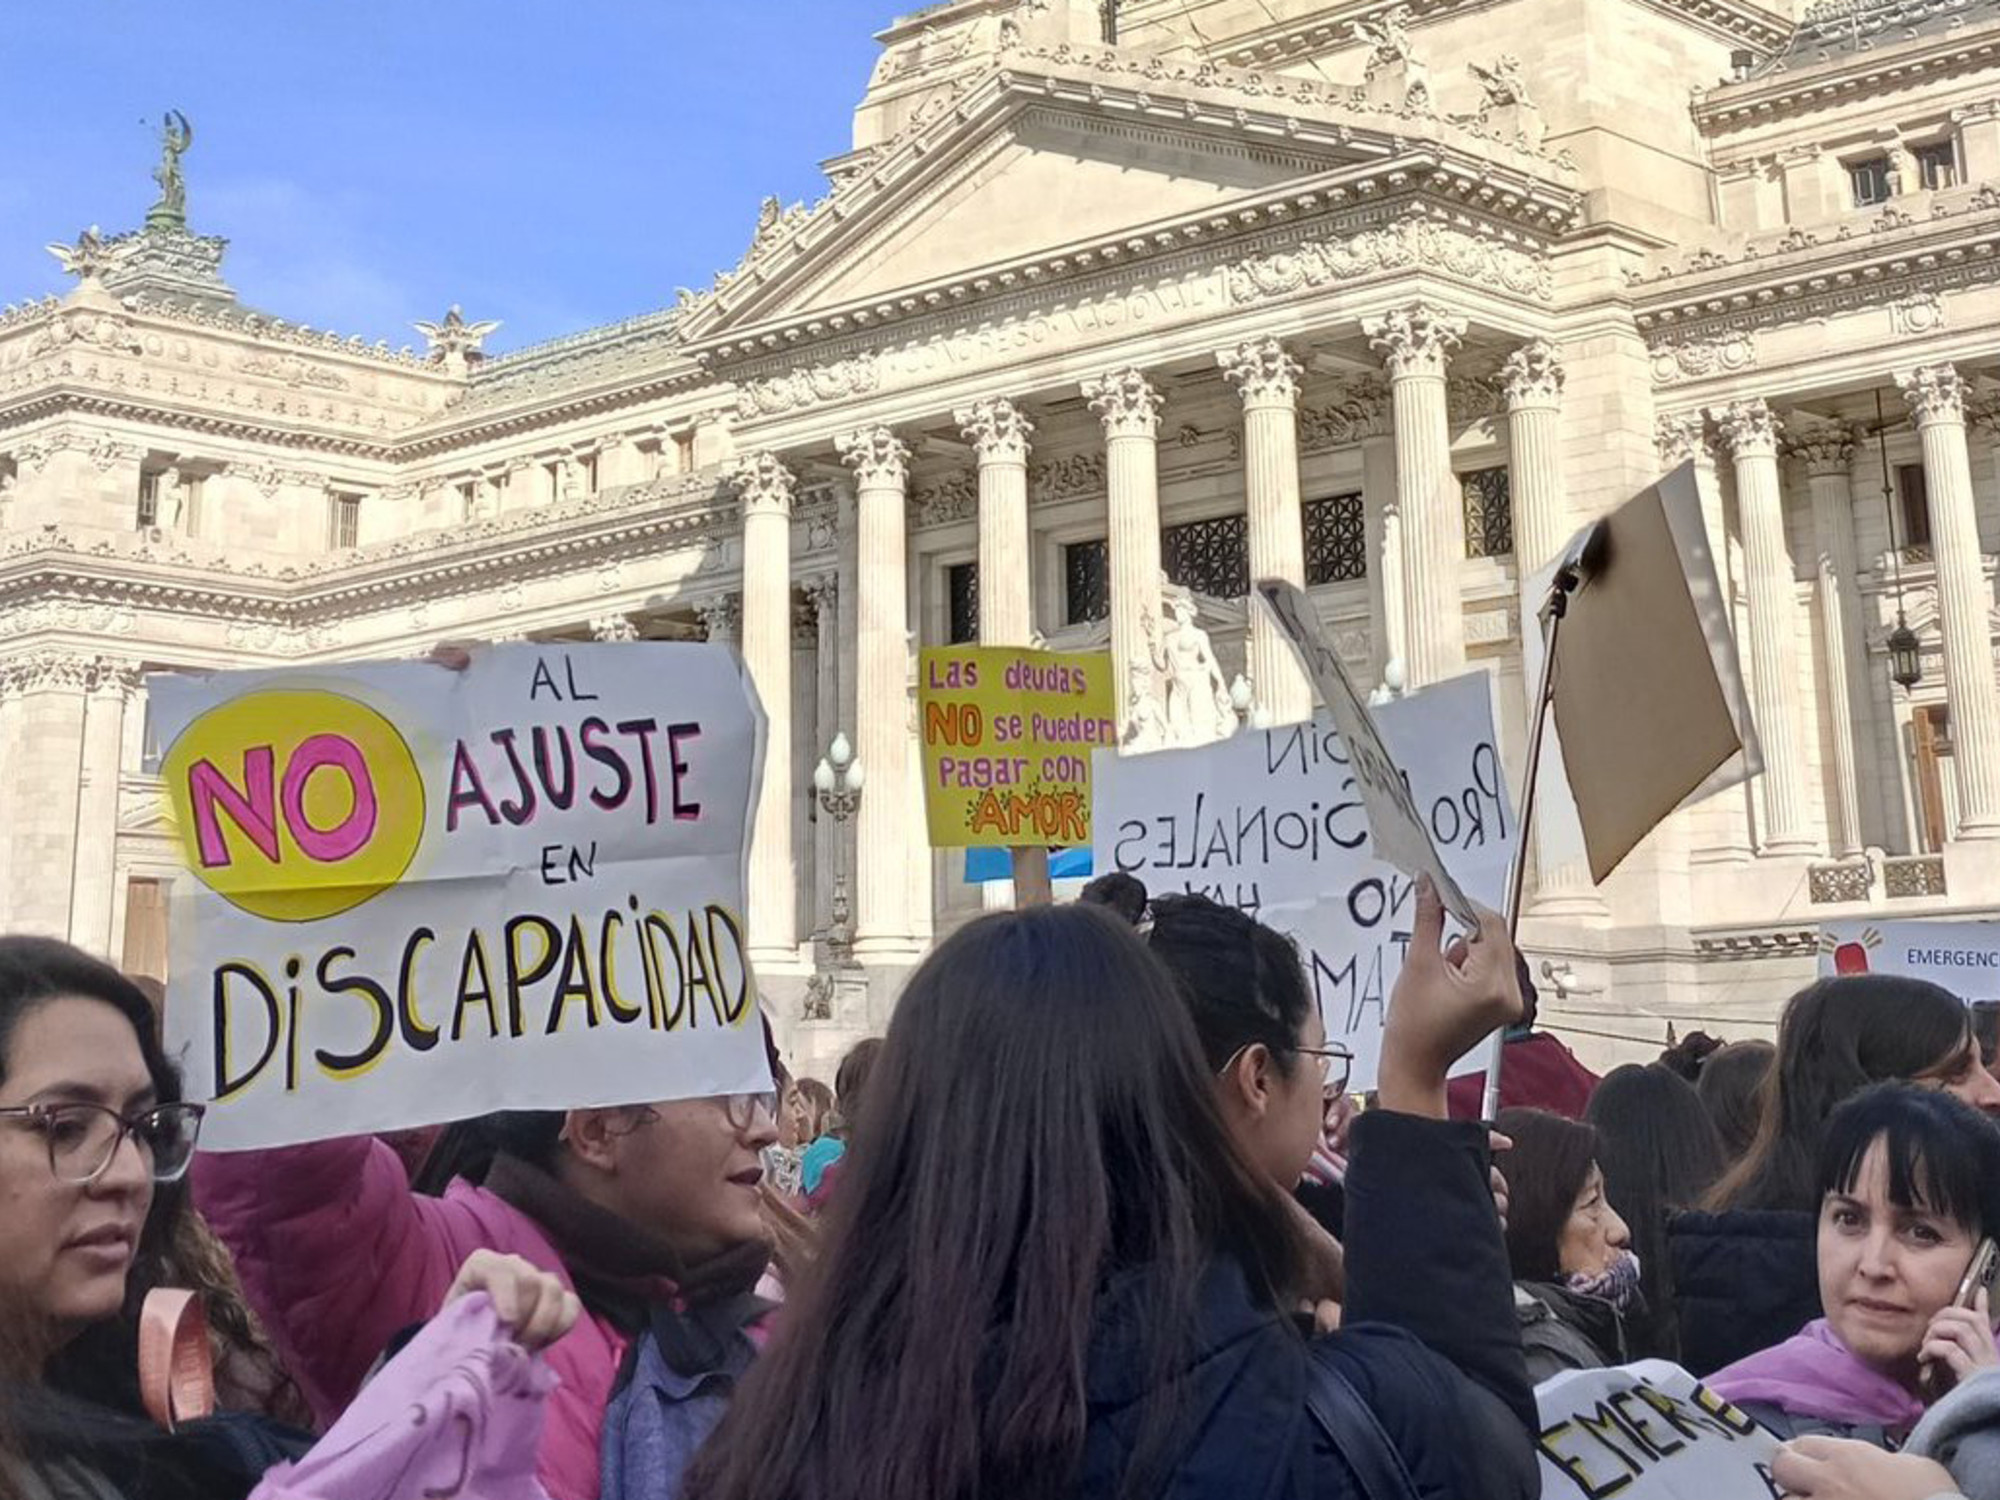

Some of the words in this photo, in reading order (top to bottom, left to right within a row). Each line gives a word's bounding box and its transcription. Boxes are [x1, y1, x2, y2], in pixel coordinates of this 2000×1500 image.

[530, 654, 599, 702] AL
[929, 659, 978, 690] Las
[1005, 659, 1087, 695] deudas
[925, 701, 983, 747] NO
[993, 713, 1022, 742] se
[445, 715, 704, 832] AJUSTE
[1042, 755, 1087, 783] con
[187, 732, 378, 868] NO
[971, 790, 1087, 840] AMOR
[540, 841, 598, 885] EN
